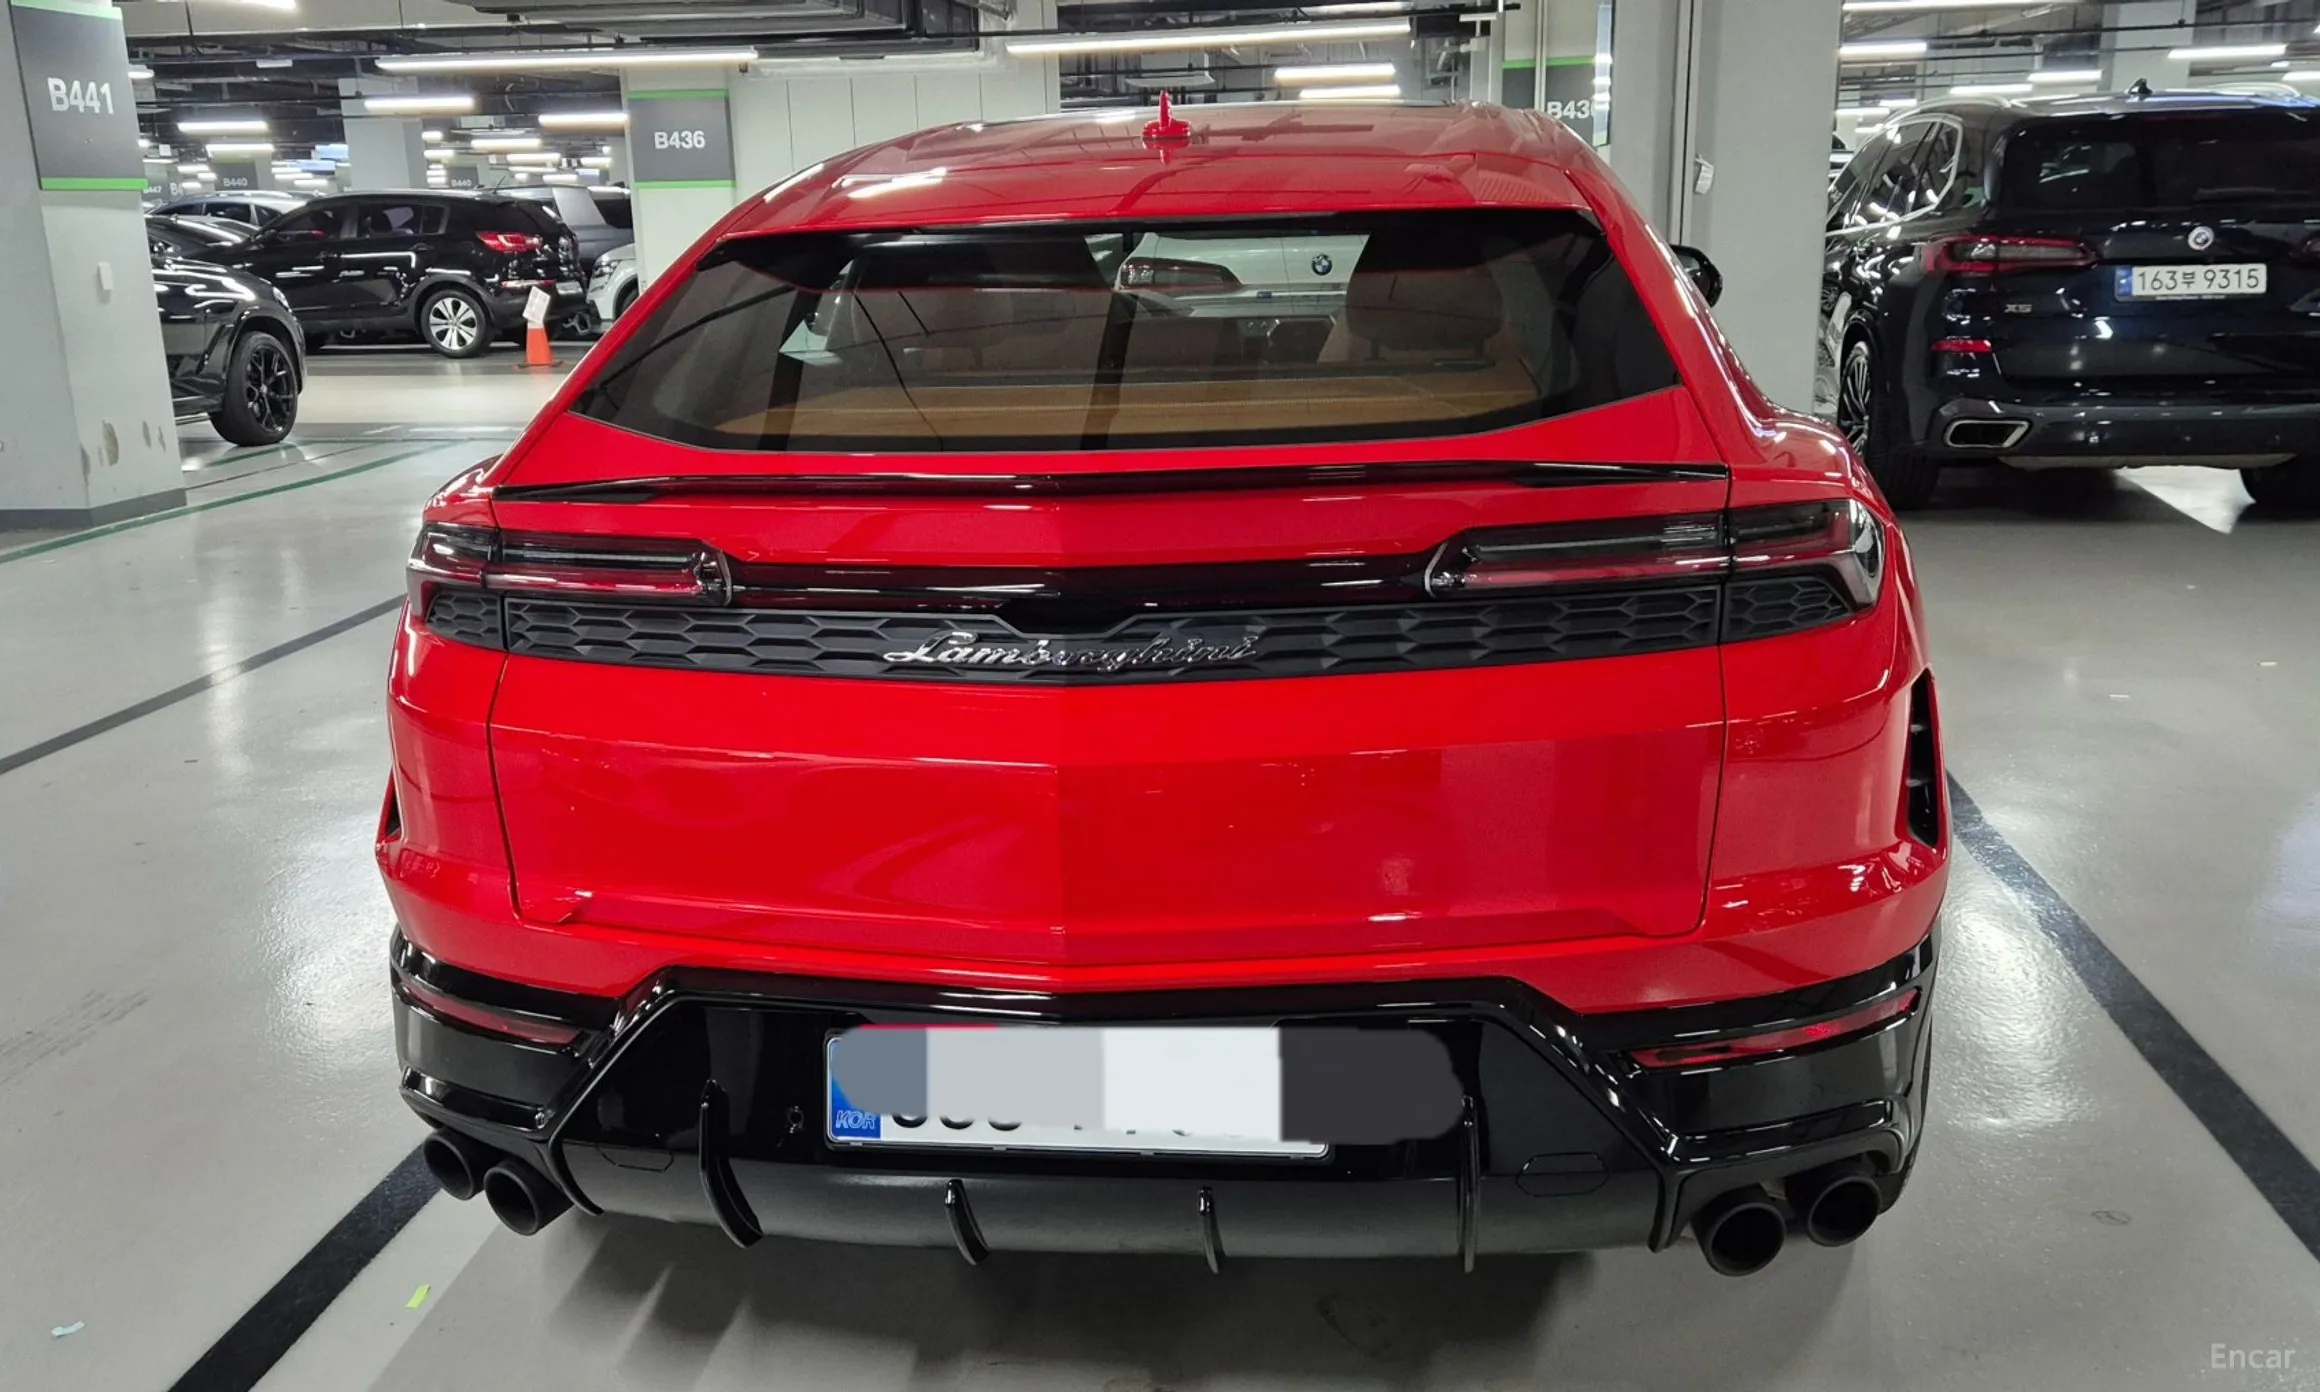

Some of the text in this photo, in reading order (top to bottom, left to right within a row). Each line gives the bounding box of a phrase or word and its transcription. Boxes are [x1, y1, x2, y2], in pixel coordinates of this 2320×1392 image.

[47, 77, 114, 115] B441
[1547, 100, 1596, 119] B43
[654, 130, 706, 149] B436
[223, 178, 248, 187] B440
[2138, 268, 2260, 291] 163부 9315
[883, 631, 1259, 673] Lamborghini
[835, 1109, 877, 1130] KOR
